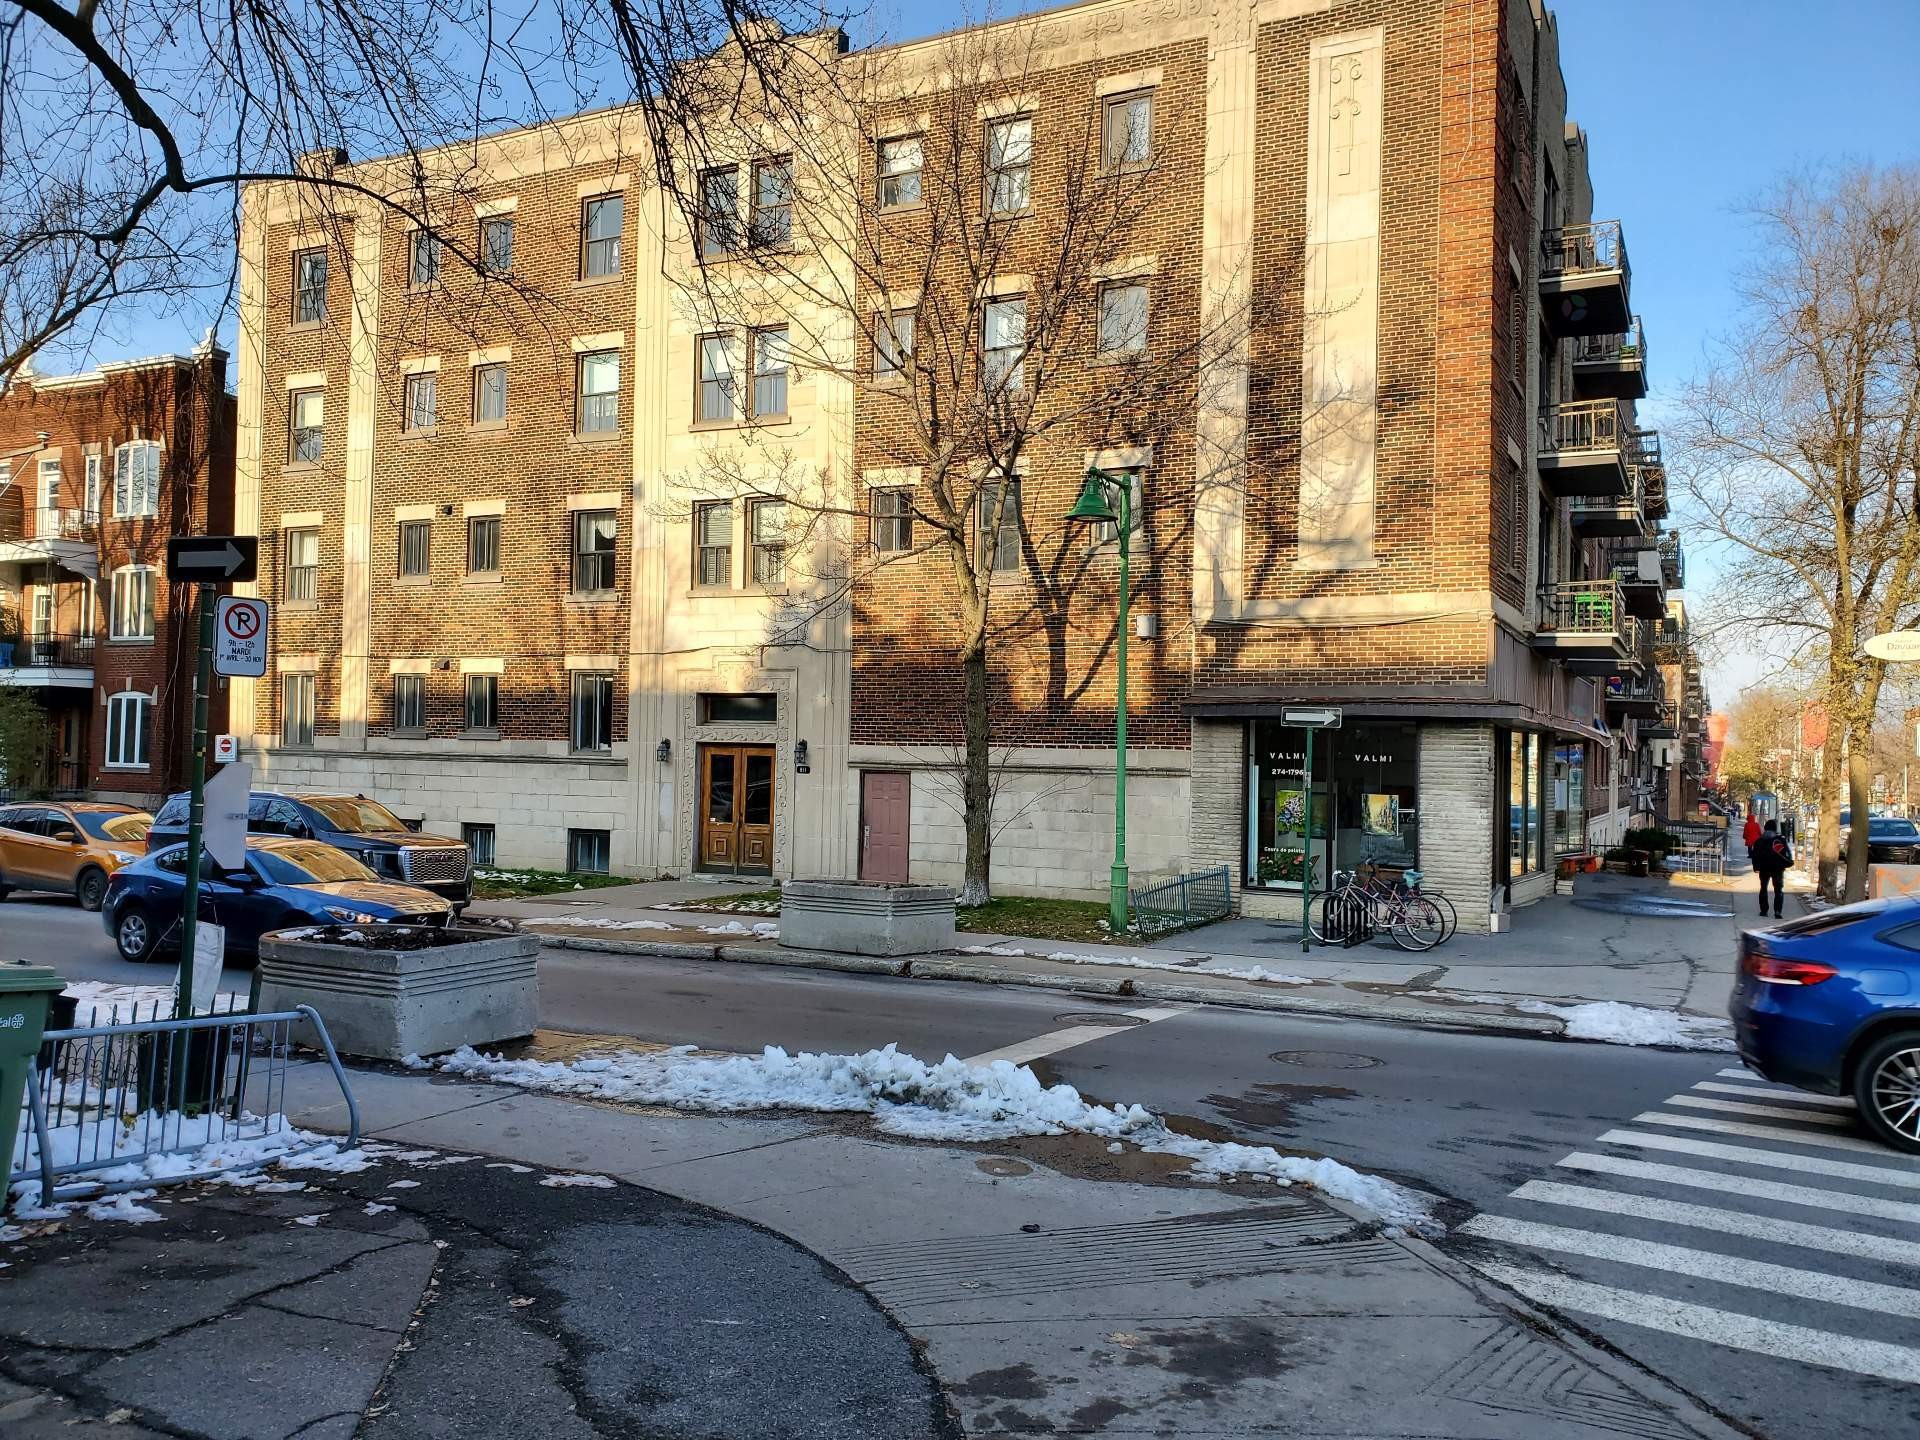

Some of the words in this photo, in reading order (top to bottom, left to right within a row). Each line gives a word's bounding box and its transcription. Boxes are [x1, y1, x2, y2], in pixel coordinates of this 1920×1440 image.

[231, 648, 251, 656] MARDI
[1269, 752, 1306, 760] VALMI
[1354, 754, 1393, 763] VALMI
[1271, 768, 1305, 776] 274-1796
